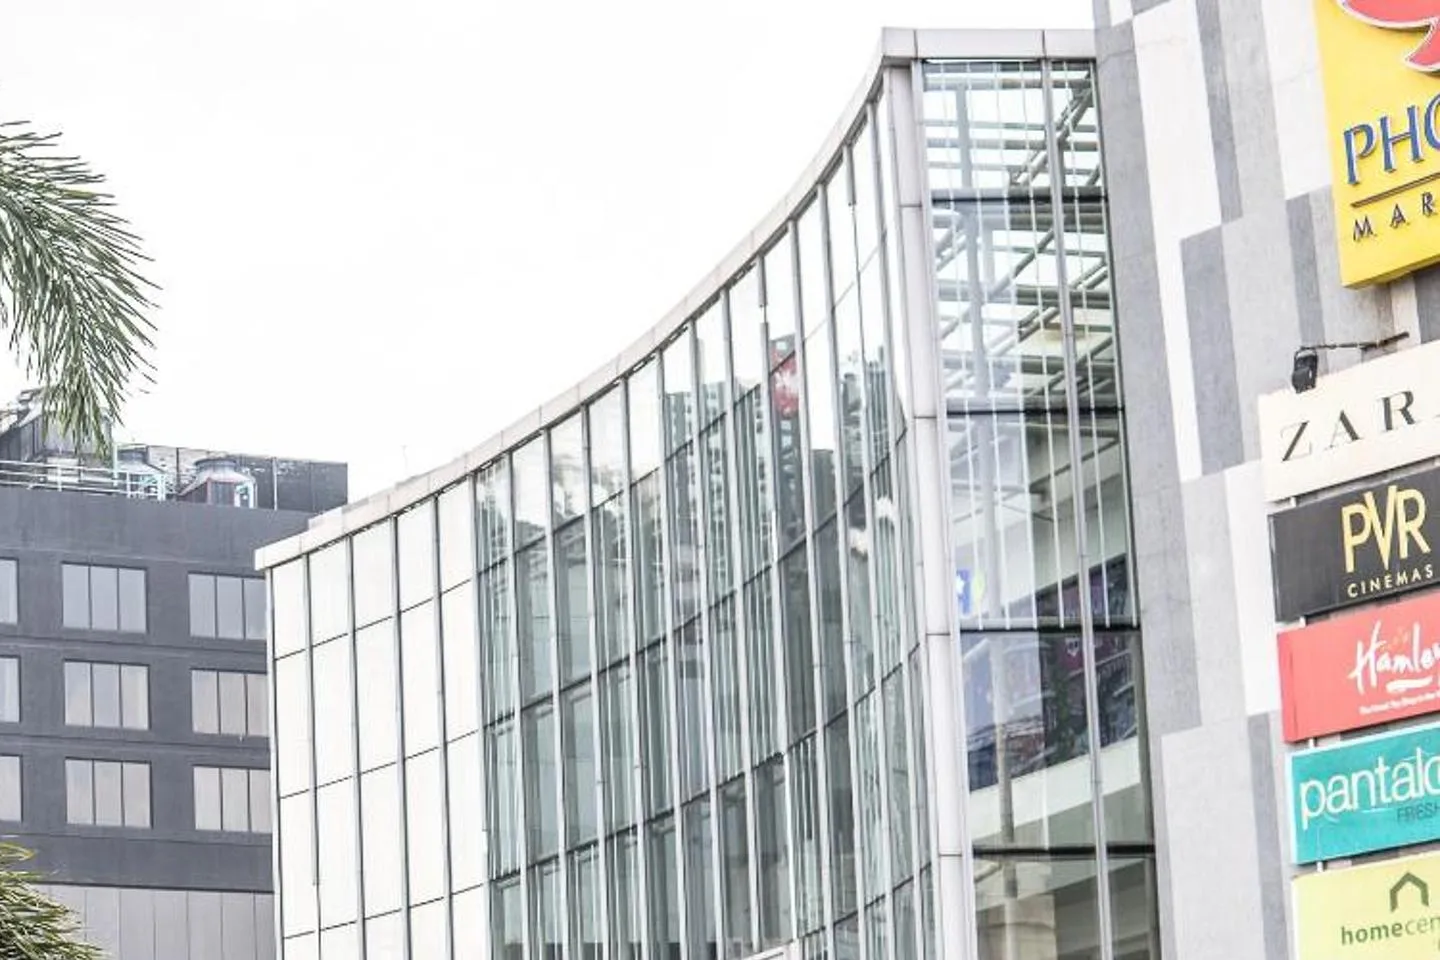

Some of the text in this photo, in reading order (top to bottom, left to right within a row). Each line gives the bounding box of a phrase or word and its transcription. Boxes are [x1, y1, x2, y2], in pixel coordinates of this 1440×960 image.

[1353, 191, 1437, 242] MAR
[1280, 389, 1440, 463] ZAR
[1341, 484, 1431, 574] PVR
[1347, 563, 1434, 599] CINEMAS
